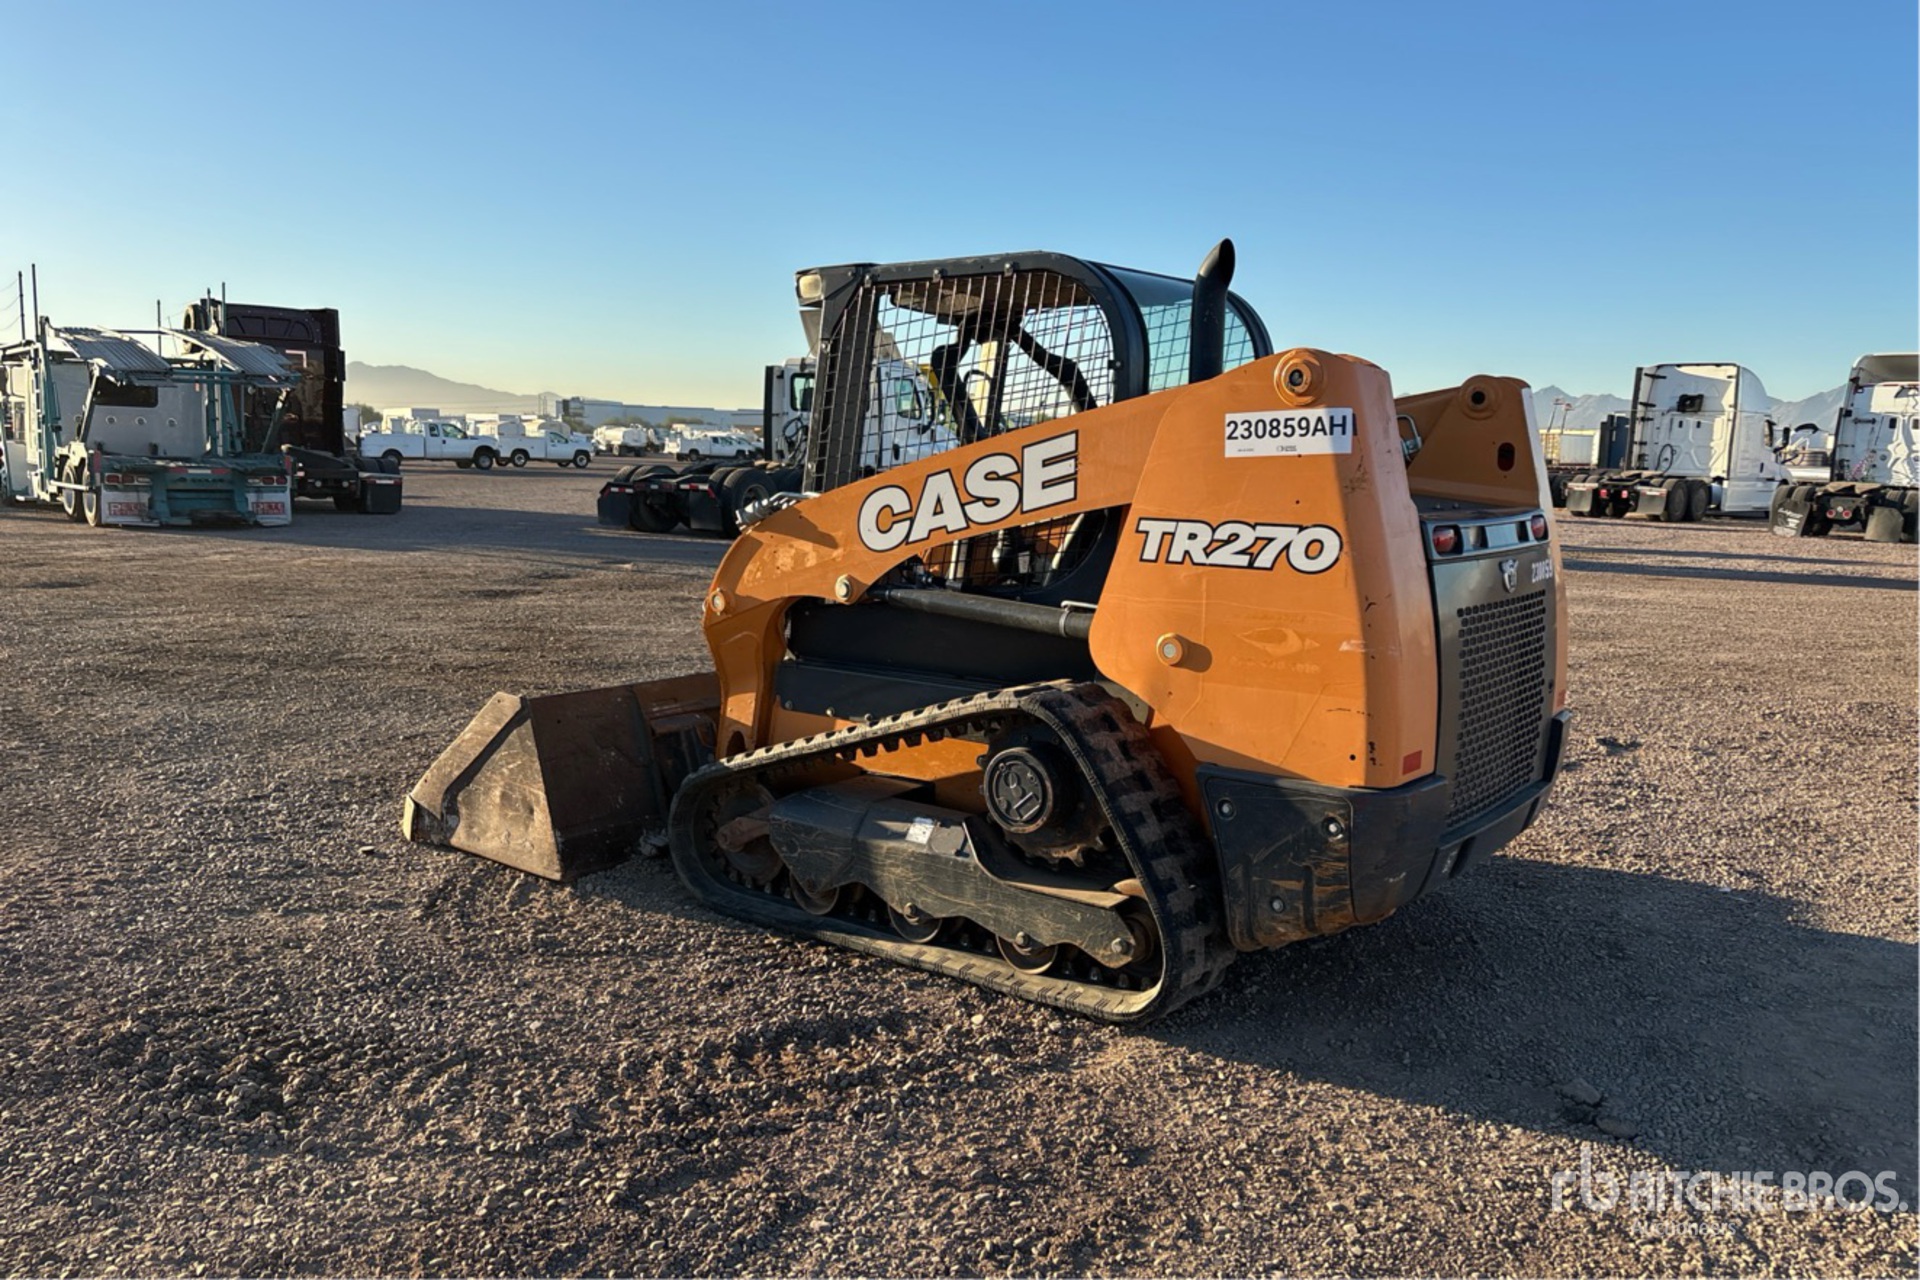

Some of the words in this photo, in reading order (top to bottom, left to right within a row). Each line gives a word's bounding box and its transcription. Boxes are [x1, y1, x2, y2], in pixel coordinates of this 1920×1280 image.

[1226, 415, 1347, 441] 230859AH
[858, 429, 1079, 552] CASE
[1136, 517, 1343, 574] TR270
